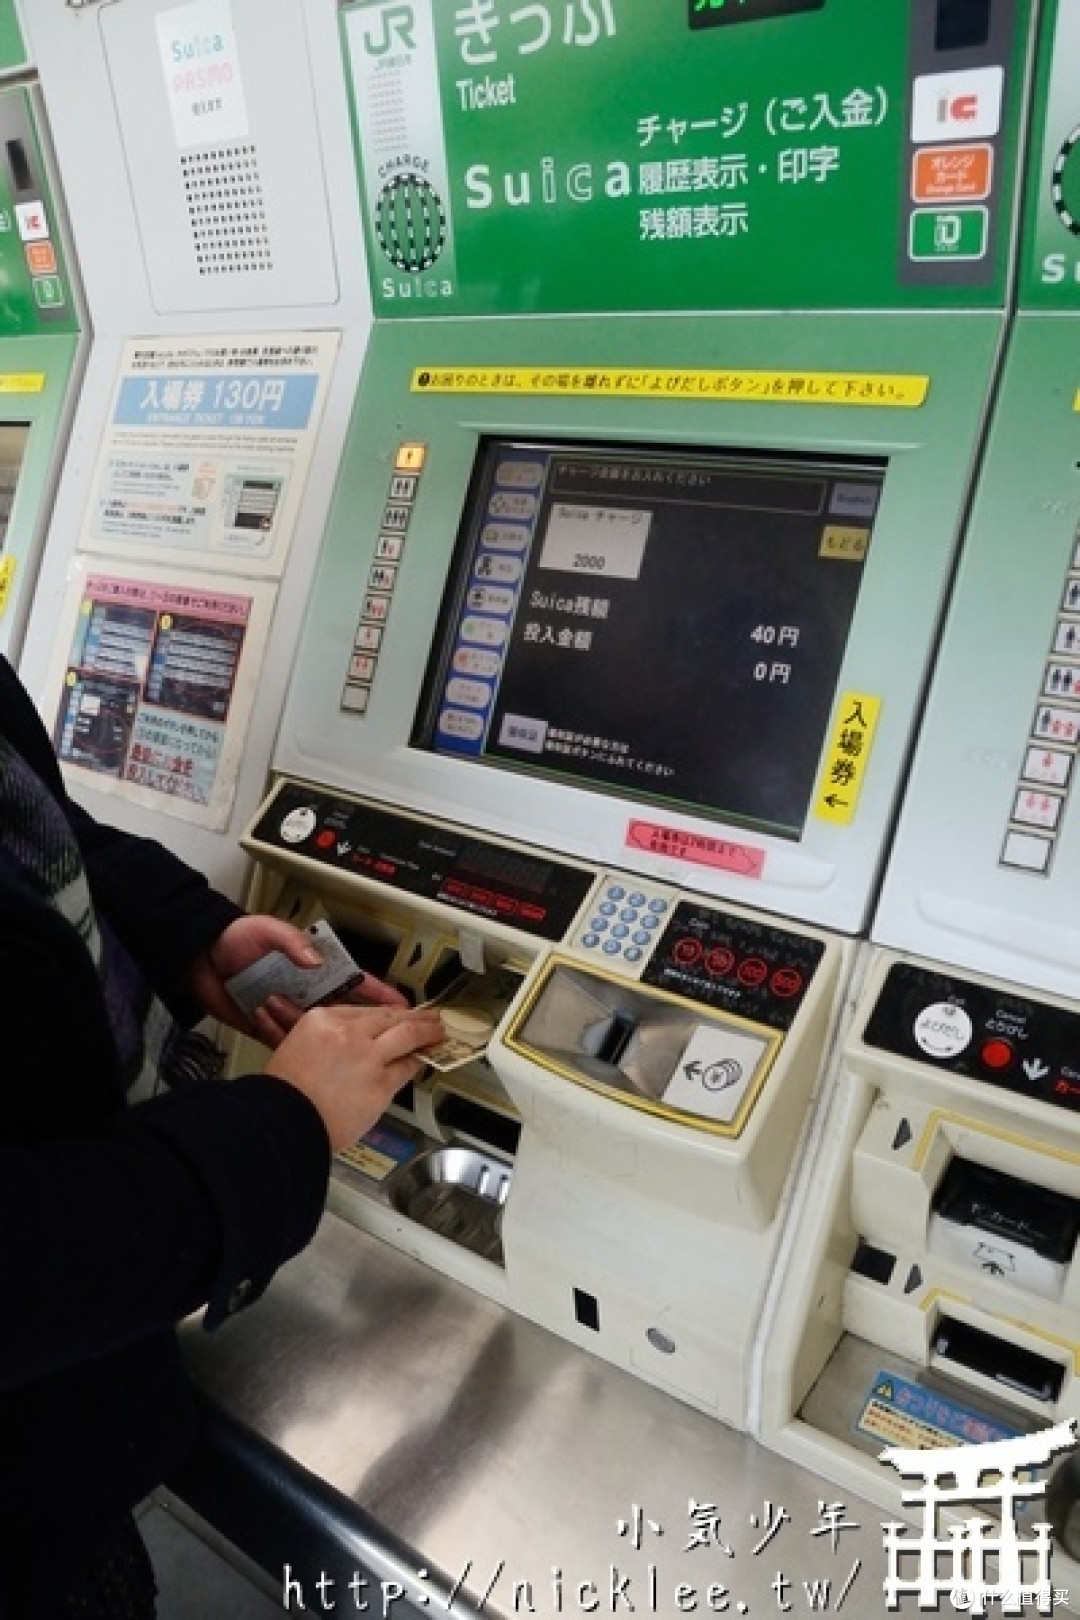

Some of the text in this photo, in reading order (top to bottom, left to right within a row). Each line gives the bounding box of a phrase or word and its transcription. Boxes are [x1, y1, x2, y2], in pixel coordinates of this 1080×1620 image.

[364, 7, 417, 56] JR
[456, 73, 517, 111] Ticket
[377, 153, 430, 179] CHARGE
[464, 156, 632, 209] Suica
[638, 202, 749, 241] 残額表示
[382, 277, 453, 299] Suica
[213, 379, 287, 411] 130円
[571, 552, 606, 571] 2000
[750, 623, 801, 648] 40円
[752, 661, 792, 684] 0円
[831, 701, 867, 786] 入場券
